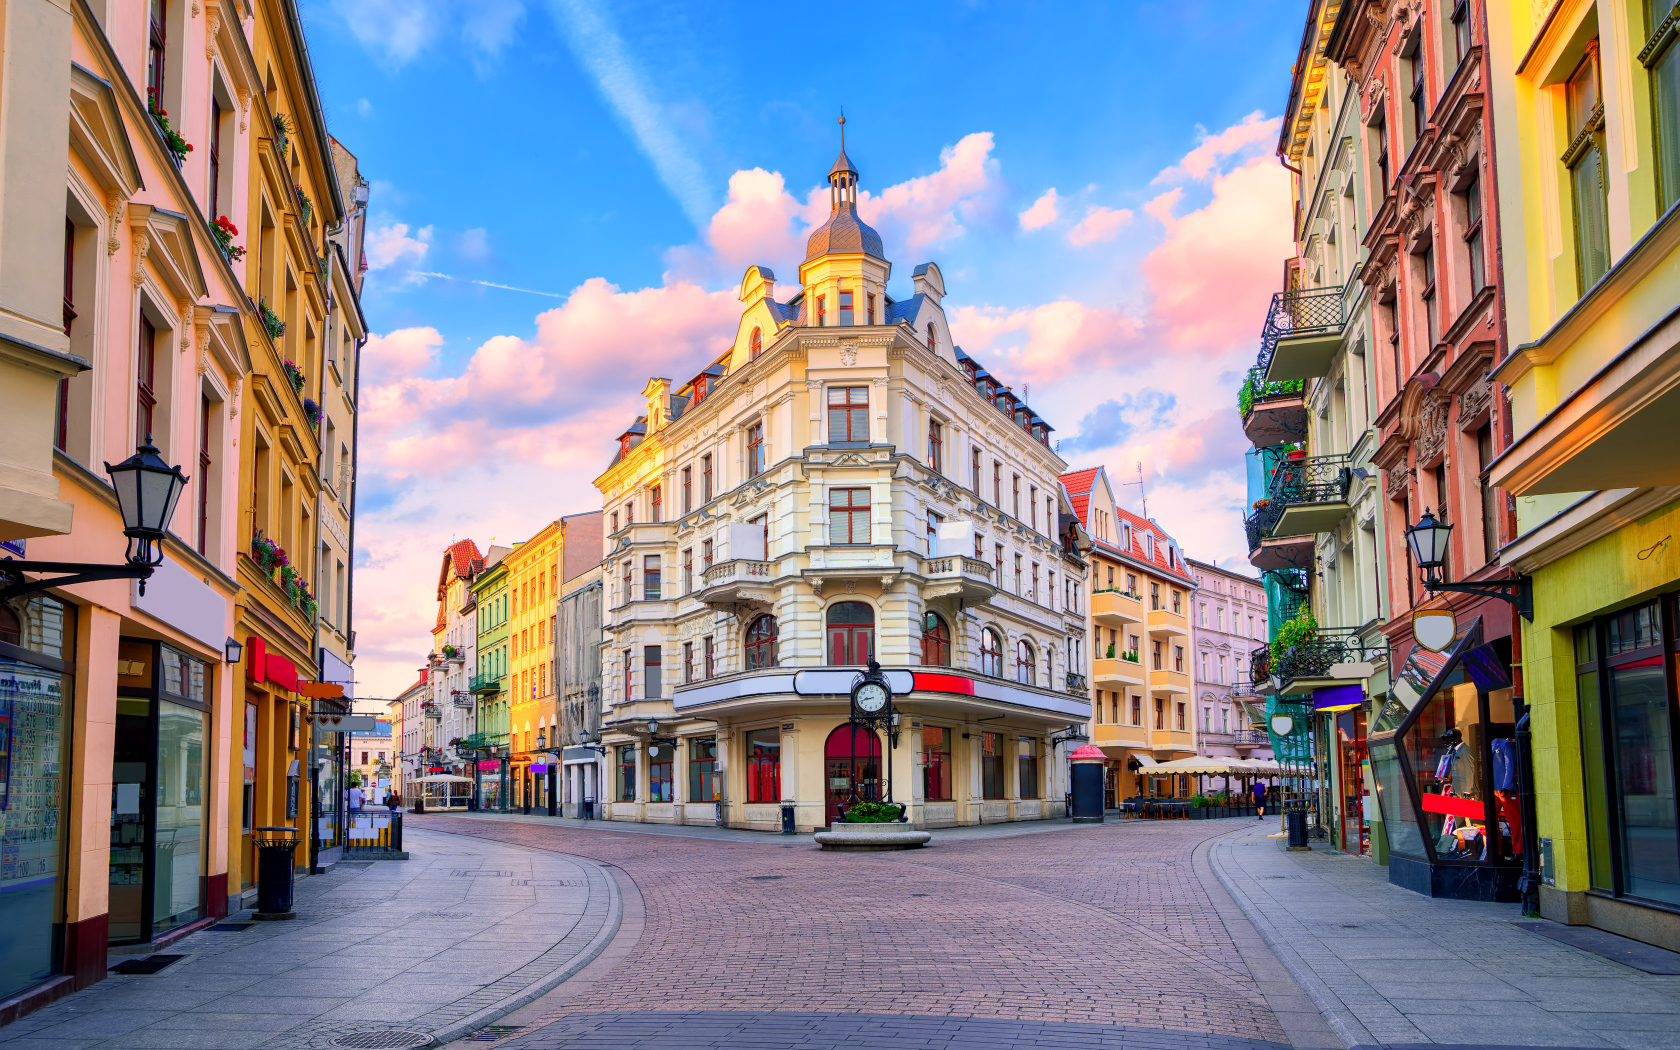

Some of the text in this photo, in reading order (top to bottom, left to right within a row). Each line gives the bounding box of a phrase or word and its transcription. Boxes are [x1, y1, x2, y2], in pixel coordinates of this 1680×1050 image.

[26, 713, 36, 729] 578
[25, 729, 36, 744] 395
[24, 746, 35, 761] 295
[23, 762, 34, 777] 278
